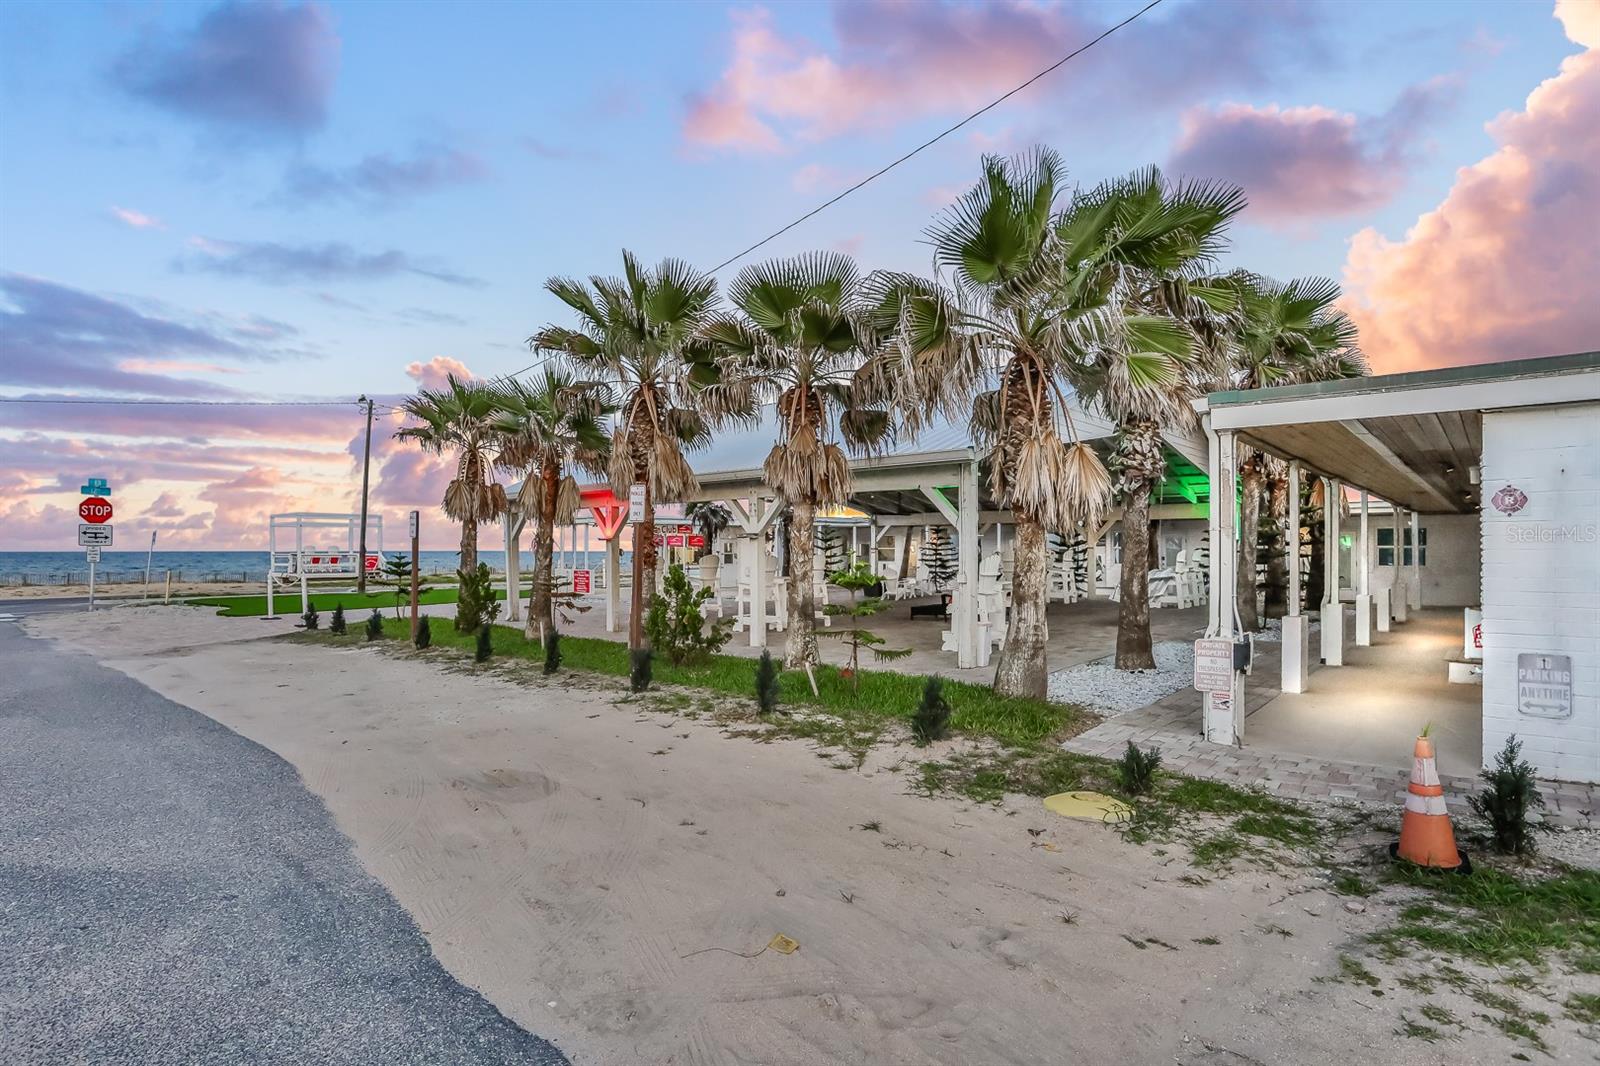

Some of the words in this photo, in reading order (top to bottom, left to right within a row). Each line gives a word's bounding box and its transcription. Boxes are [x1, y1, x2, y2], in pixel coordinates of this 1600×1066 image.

[81, 505, 111, 516] STOP
[1197, 649, 1229, 657] PROPERTY
[1536, 656, 1552, 669] NO
[1199, 665, 1230, 673] TRESPASSING
[1520, 669, 1570, 683] PARKING
[1521, 686, 1569, 700] ANYTIME
